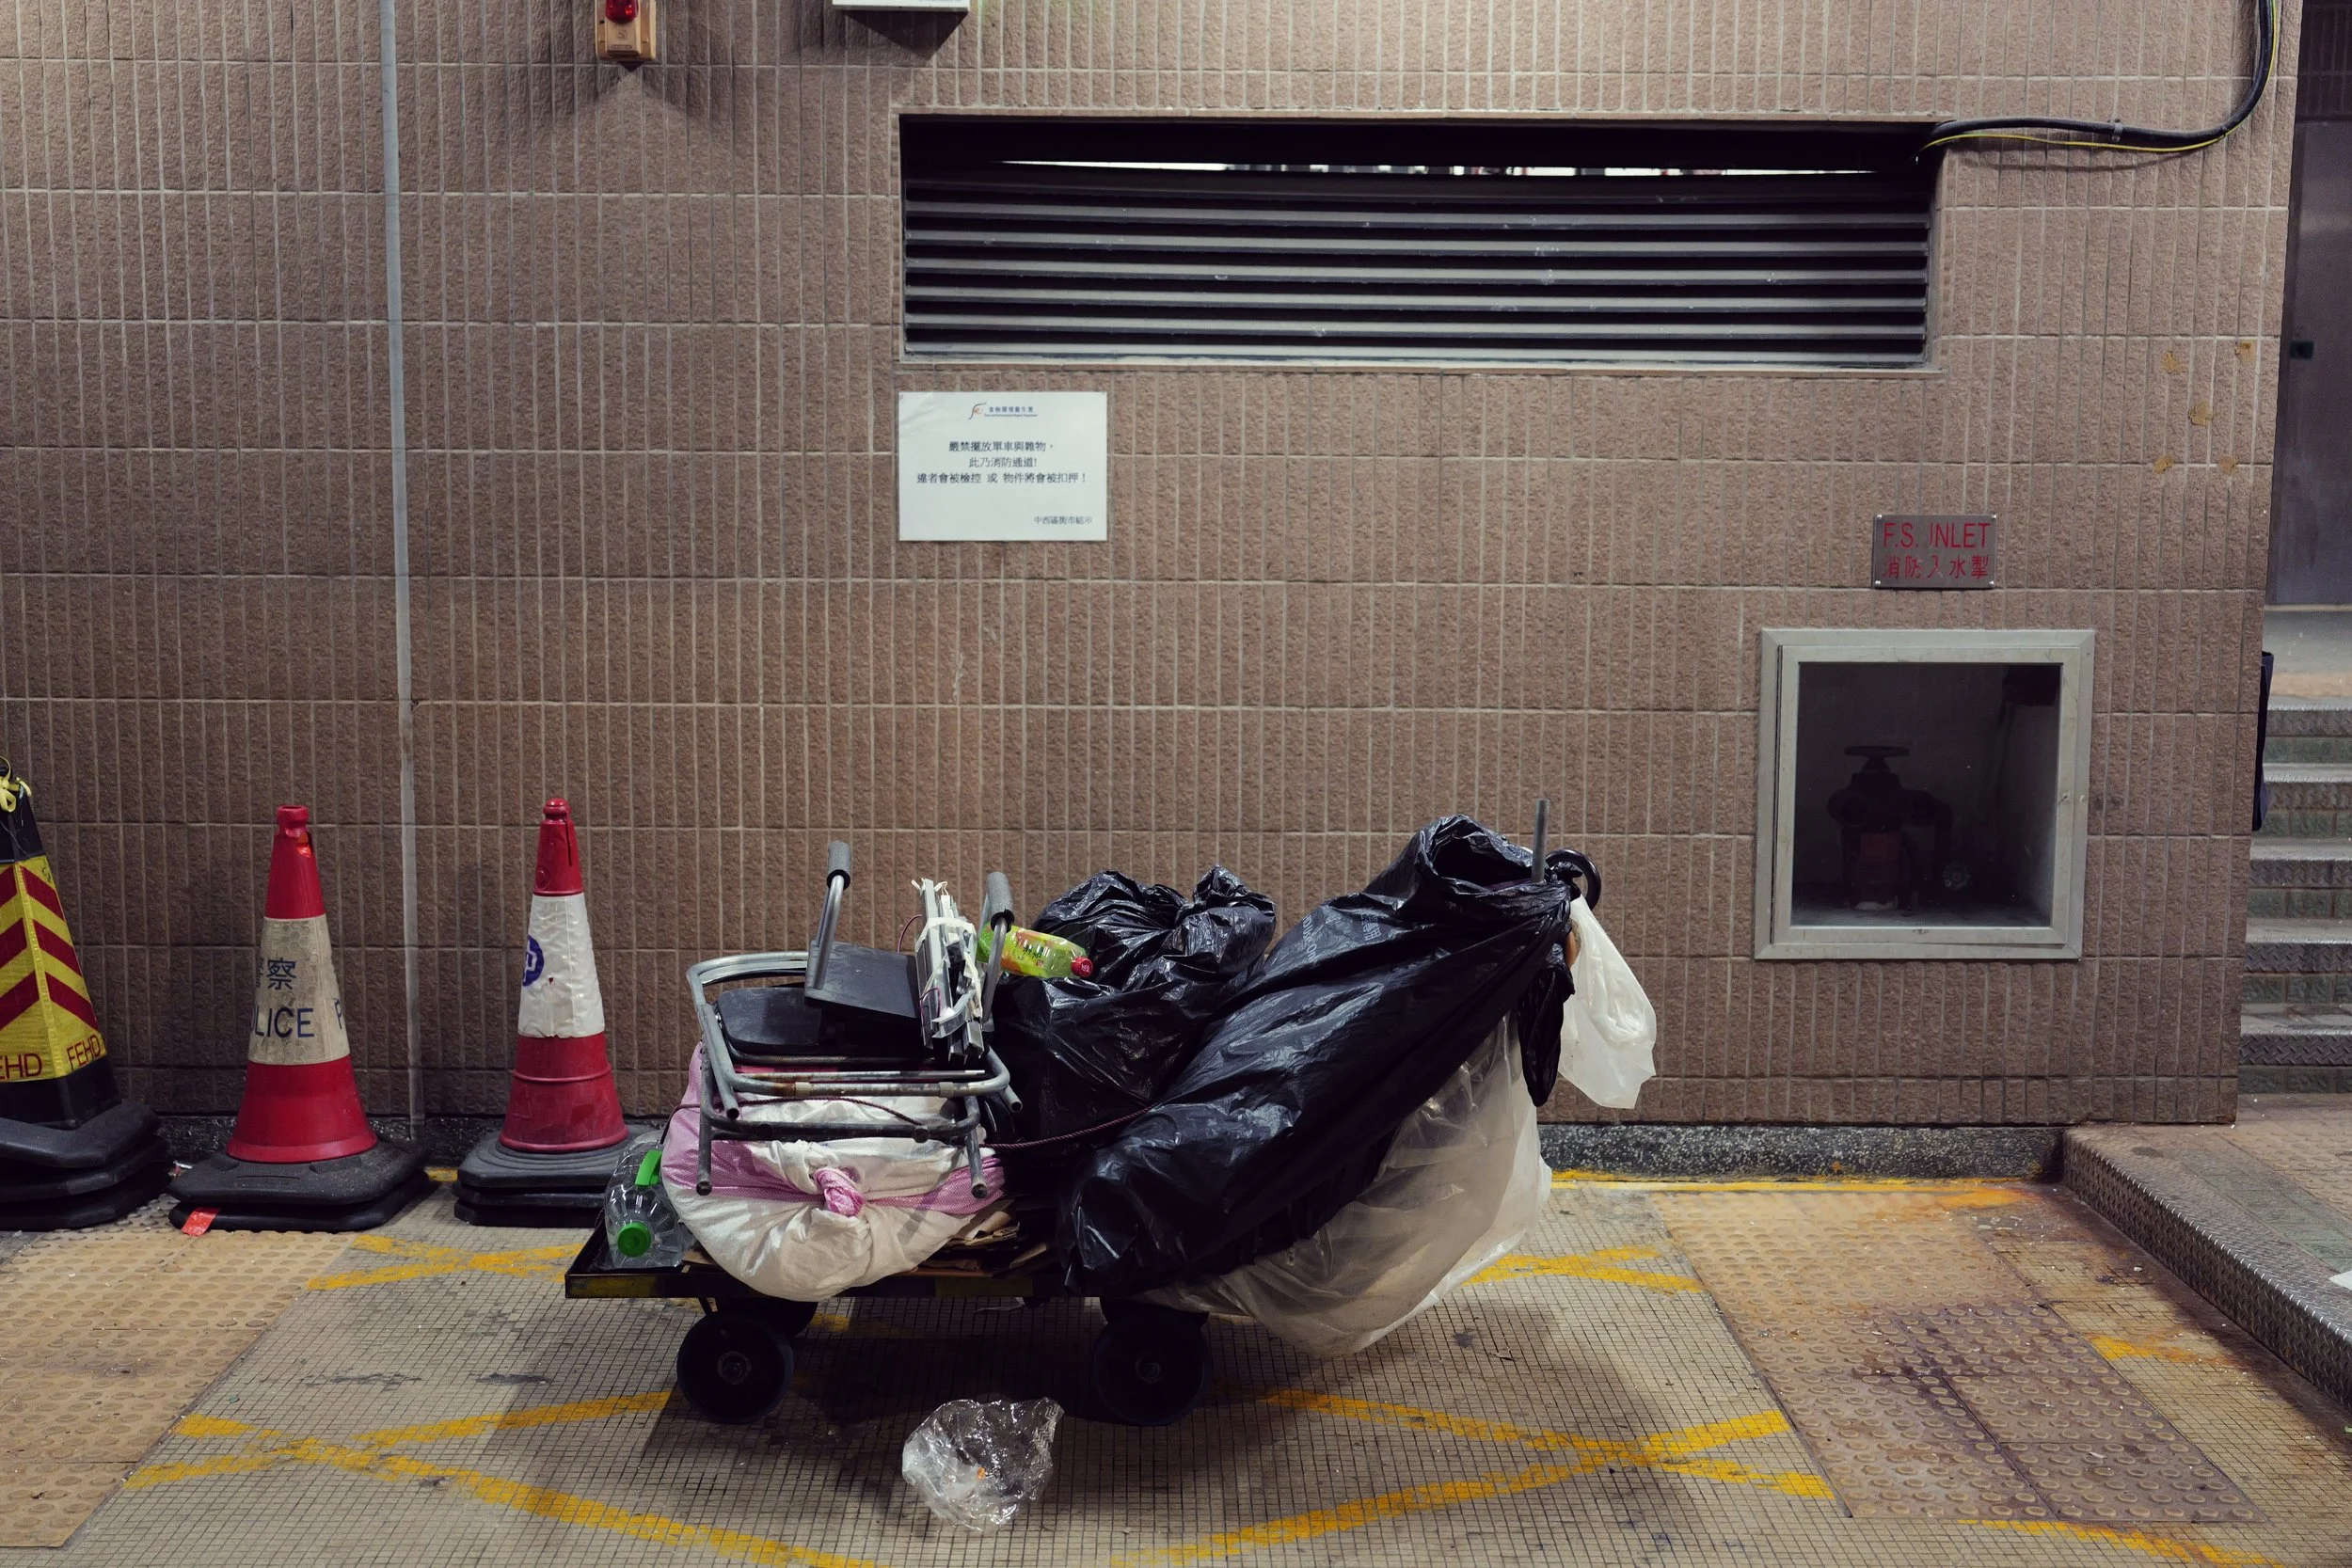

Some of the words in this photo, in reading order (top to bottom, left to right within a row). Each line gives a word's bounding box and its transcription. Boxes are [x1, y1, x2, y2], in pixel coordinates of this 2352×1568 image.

[1883, 522, 1919, 548] F.S.
[1929, 522, 1992, 548] INLET
[251, 1002, 315, 1039] LICE
[66, 1034, 102, 1071] FEHD
